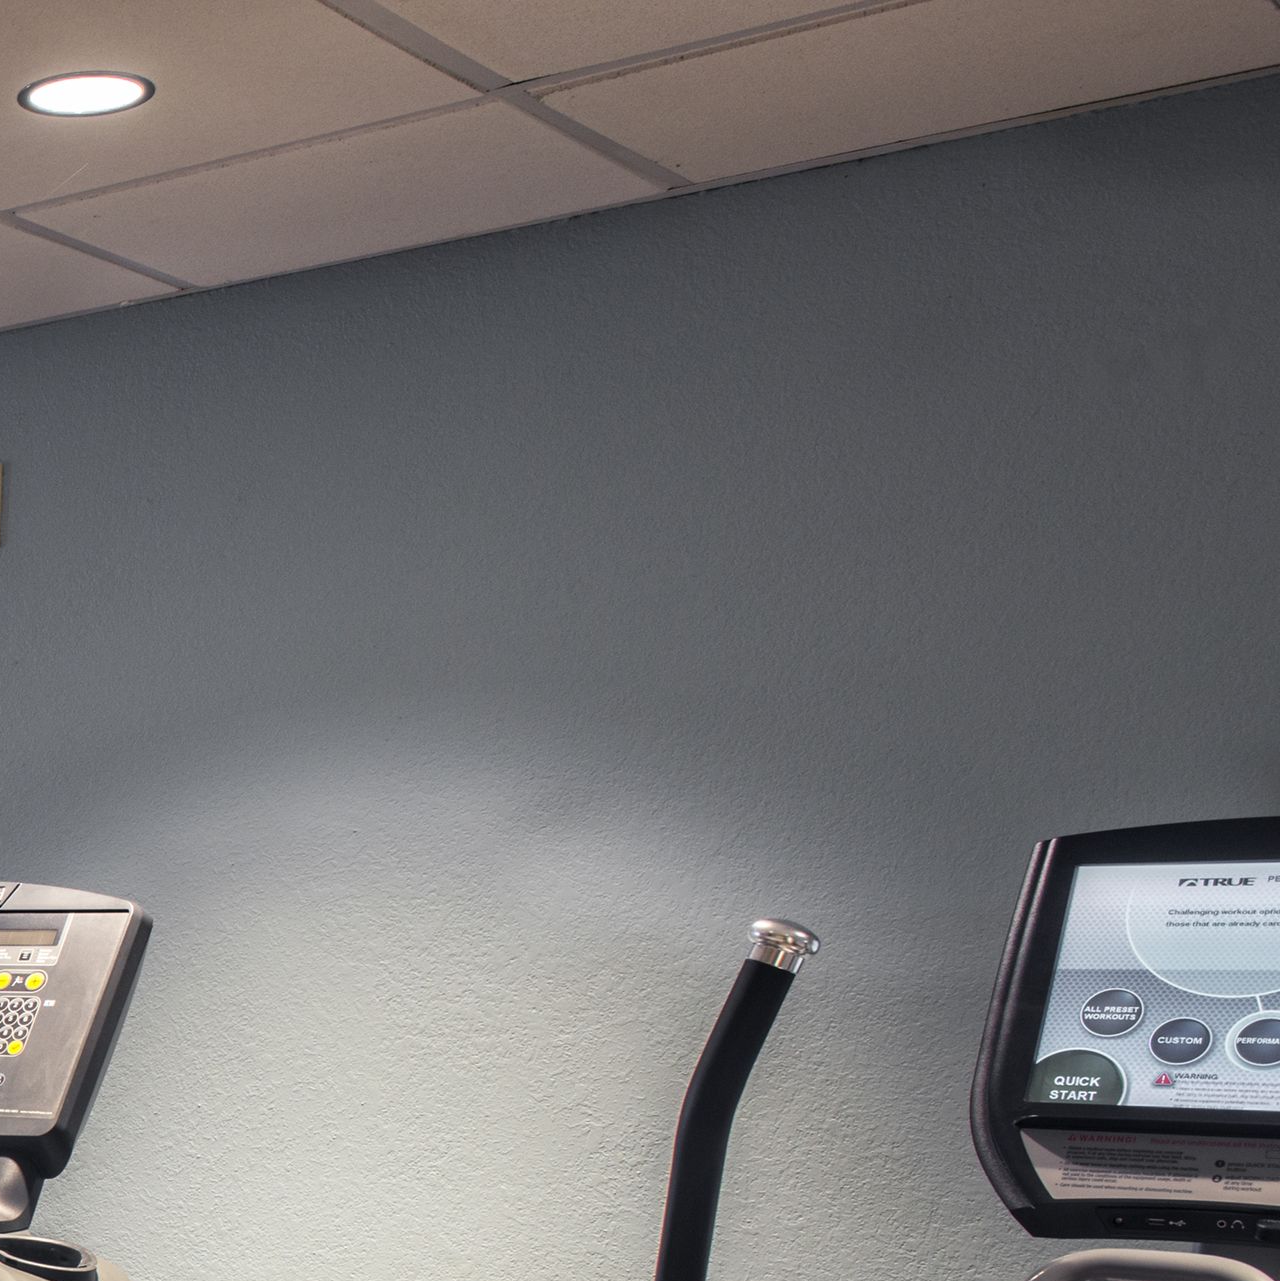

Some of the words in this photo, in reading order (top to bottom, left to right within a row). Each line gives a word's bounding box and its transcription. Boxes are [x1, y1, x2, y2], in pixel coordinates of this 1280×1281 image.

[1200, 876, 1257, 887] TRUE
[1168, 908, 1219, 916] Challenging
[1166, 920, 1190, 928] those
[1192, 920, 1210, 928] that
[1228, 920, 1261, 928] already
[1084, 1013, 1137, 1021] WORKOUTS
[1157, 1036, 1203, 1045] CUSTOM
[1237, 1036, 1280, 1045] PERFORMA
[1174, 1072, 1219, 1080] WARNING
[1054, 1076, 1101, 1088] QUICK
[1049, 1089, 1097, 1101] START
